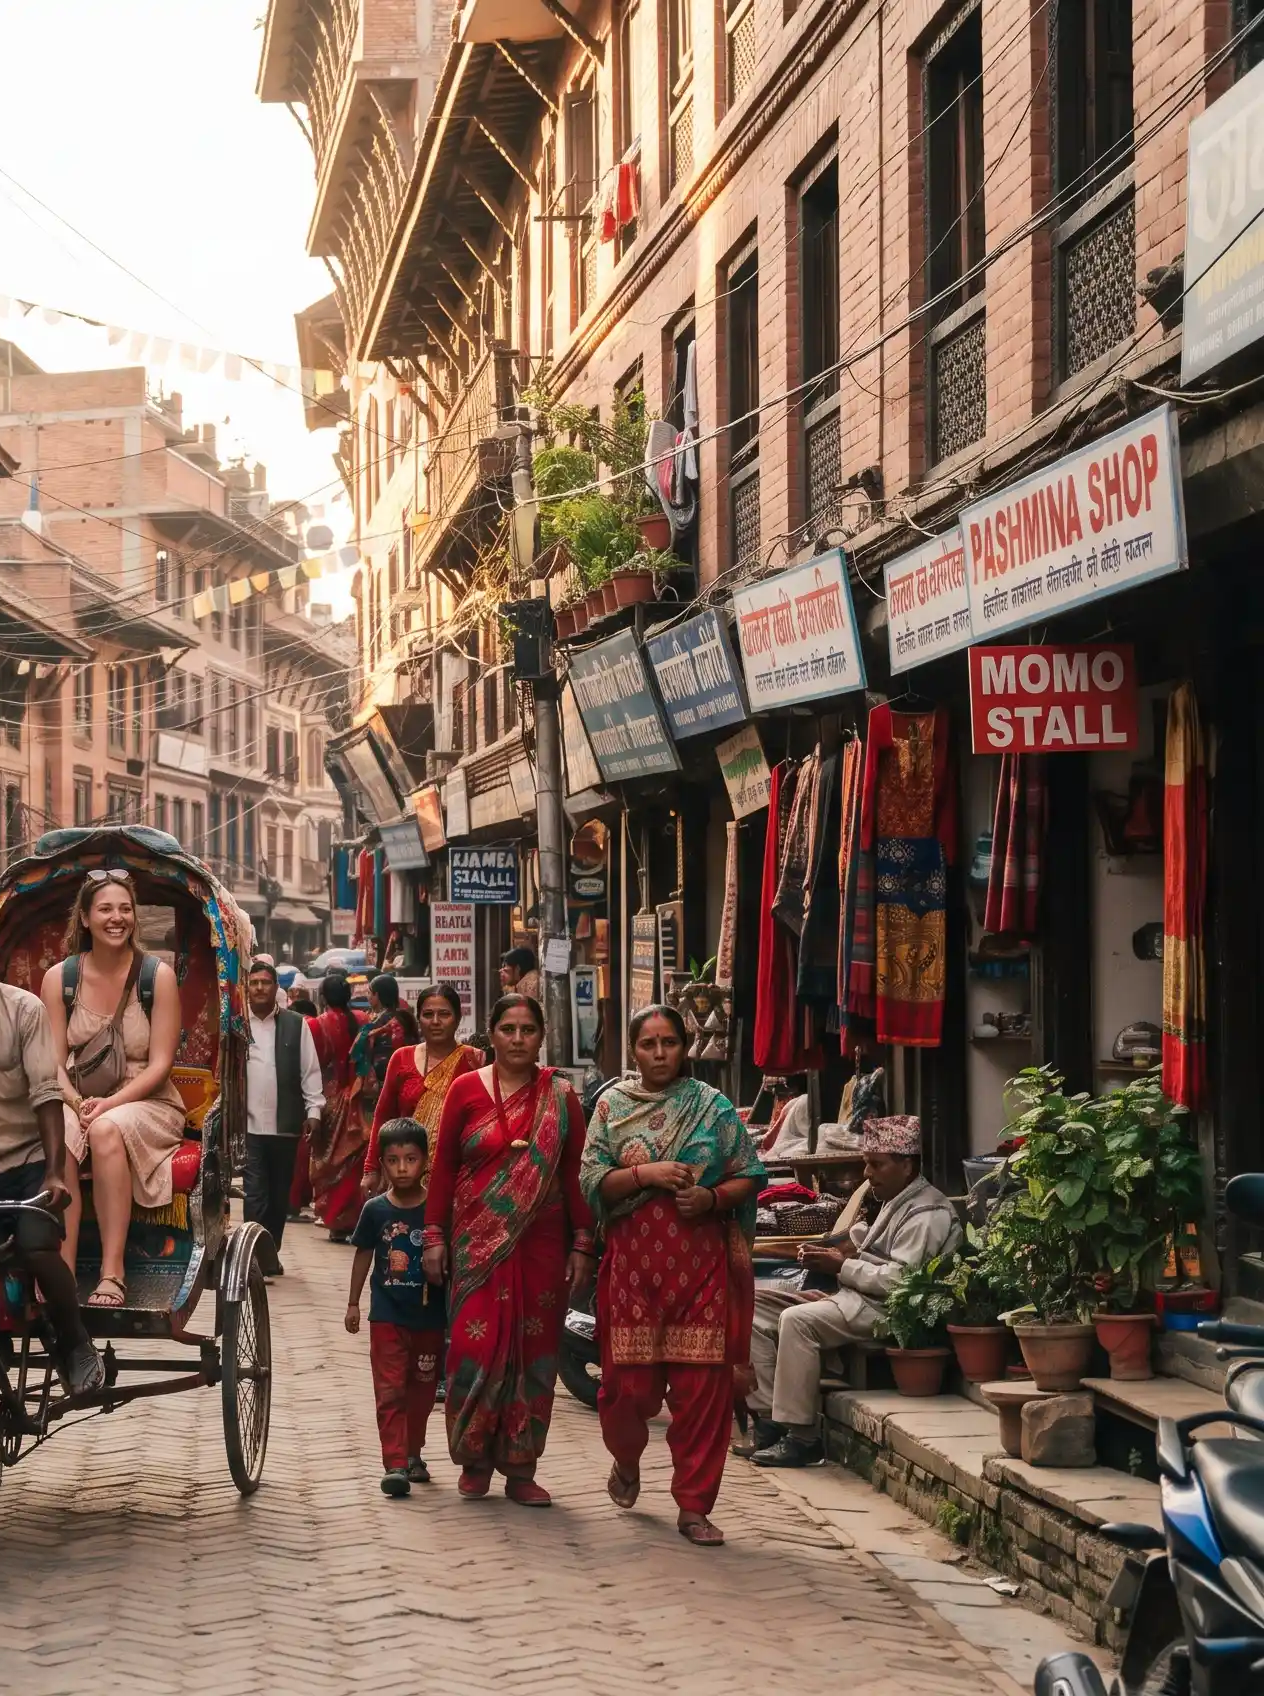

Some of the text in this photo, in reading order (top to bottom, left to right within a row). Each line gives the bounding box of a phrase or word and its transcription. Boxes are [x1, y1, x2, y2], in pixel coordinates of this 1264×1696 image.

[969, 474, 1083, 585] PASHMINA
[1087, 433, 1159, 534] SHOP
[980, 651, 1124, 695] MOMO
[987, 704, 1128, 748] STALL
